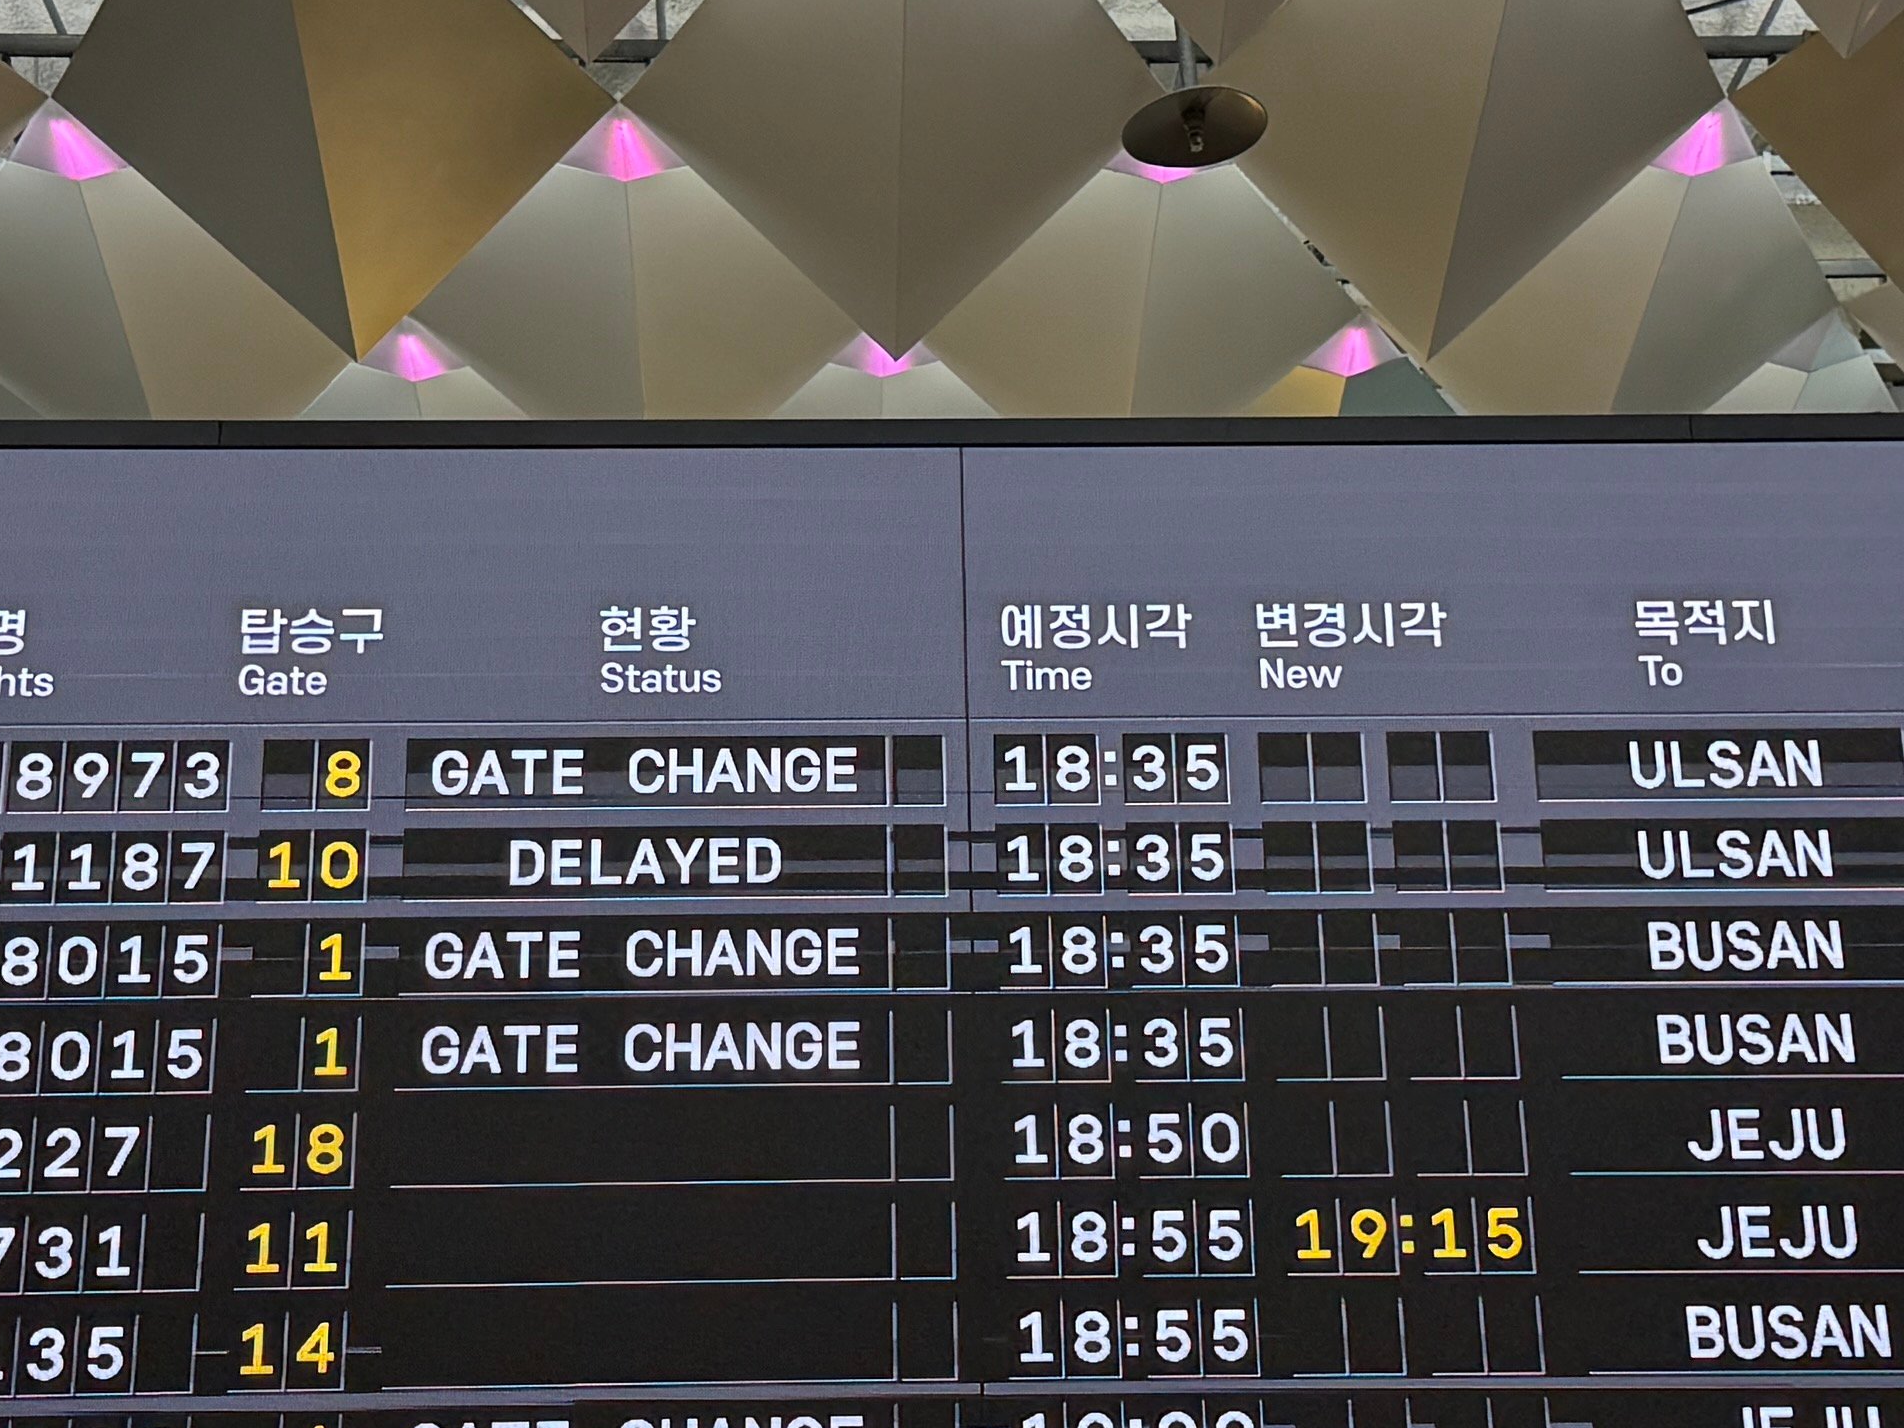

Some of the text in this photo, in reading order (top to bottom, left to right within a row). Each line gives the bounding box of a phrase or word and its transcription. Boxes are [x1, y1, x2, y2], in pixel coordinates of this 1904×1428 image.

[241, 608, 384, 655] 탑승구
[599, 605, 697, 652] 현황
[1001, 603, 1193, 649] 예정시각
[1256, 601, 1447, 648] 변경시각
[1634, 599, 1776, 646] 목적지
[238, 664, 328, 696] Gate
[600, 661, 722, 693] Status
[1000, 660, 1092, 691] Time
[1259, 657, 1343, 689] New
[1638, 655, 1683, 686] To
[325, 750, 361, 798] 8
[431, 749, 584, 796] GATE
[628, 747, 858, 794] CHANGE
[1004, 741, 1220, 792] 18:35
[1629, 739, 1823, 790] ULSAN
[268, 841, 359, 889] 10
[509, 837, 782, 886] DELAYED
[1007, 833, 1224, 883] 18:35
[1637, 829, 1833, 880] ULSAN
[319, 933, 352, 981] 1
[425, 930, 581, 980] GATE
[626, 928, 860, 977] CHANGE
[1017, 1209, 1244, 1263] 18:55
[1296, 1207, 1523, 1259] 19:15
[1697, 1205, 1858, 1260] JEJU
[240, 1322, 335, 1375] 14
